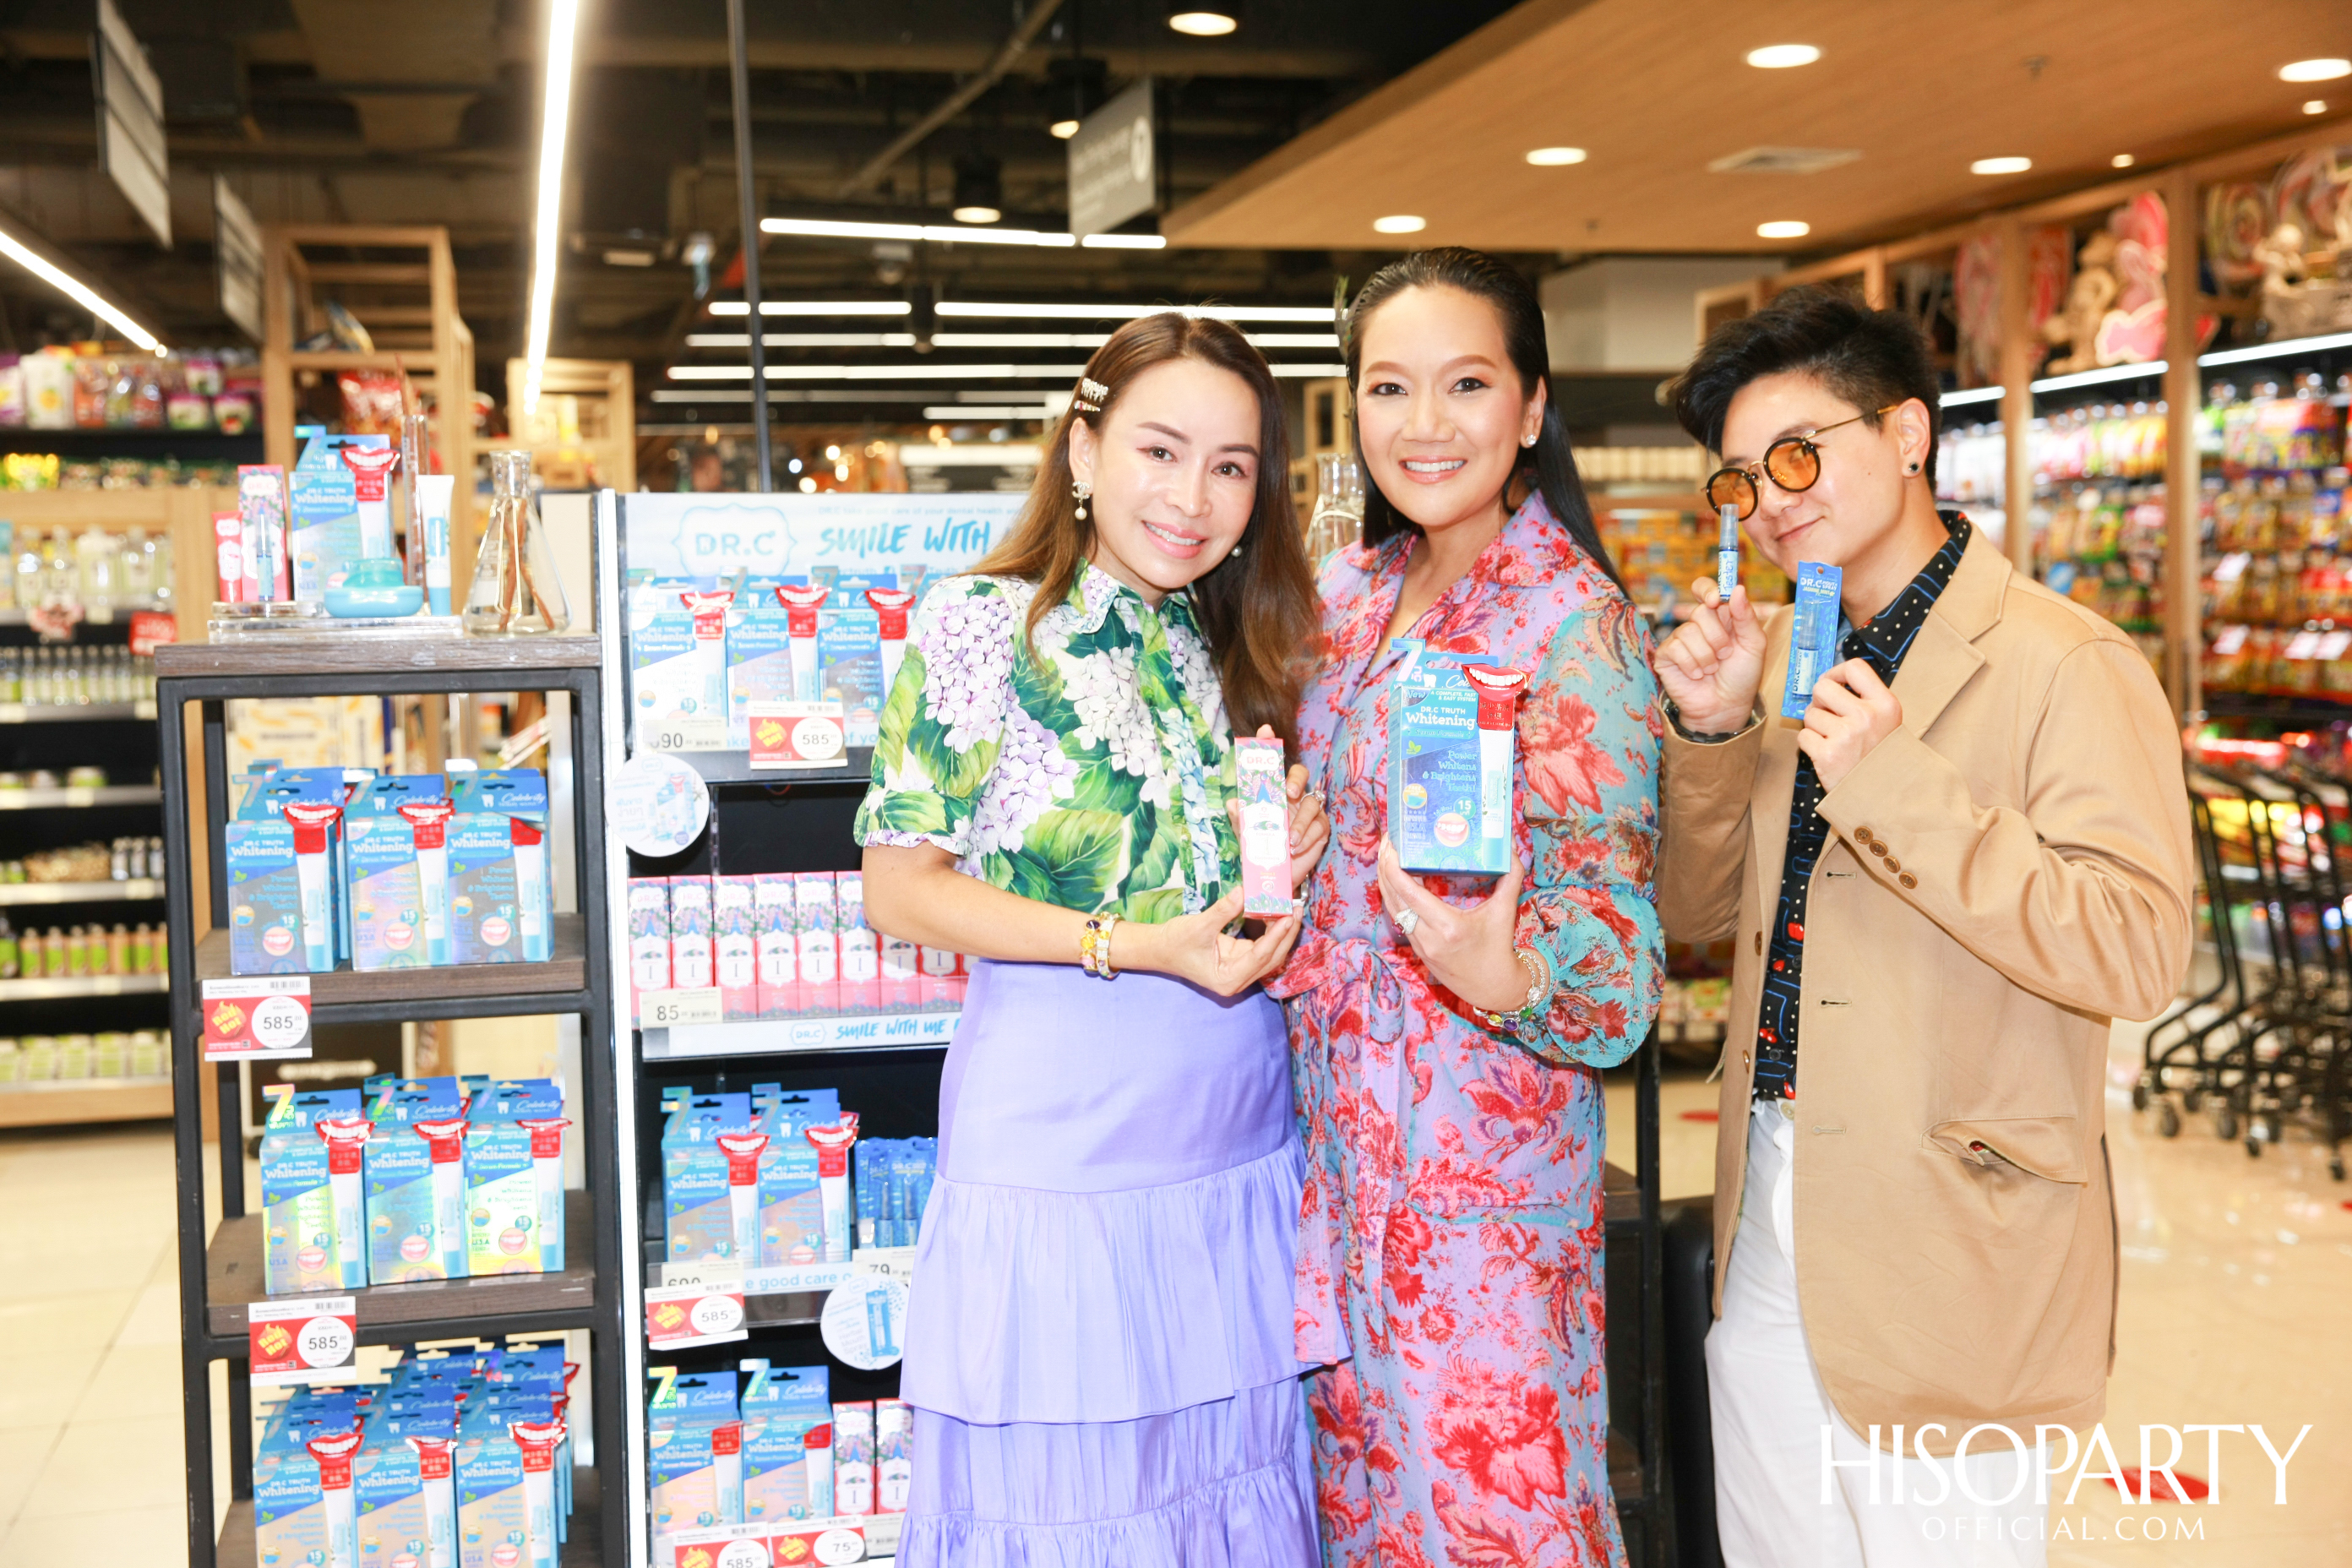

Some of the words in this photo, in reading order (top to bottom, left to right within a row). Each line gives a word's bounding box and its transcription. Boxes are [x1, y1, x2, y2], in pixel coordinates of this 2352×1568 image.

[295, 494, 355, 506] Whitening
[695, 531, 775, 556] DR.C
[816, 522, 912, 559] SMILE
[923, 516, 991, 556] WITH
[1800, 577, 1823, 589] DR.C
[636, 634, 693, 644] Whitening
[730, 630, 787, 642] Whitening
[822, 632, 878, 643] Whitening
[1391, 640, 1424, 682] 7
[1407, 689, 1426, 699] New
[1440, 706, 1466, 715] TRUTH
[1405, 712, 1476, 730] Whitening
[802, 733, 830, 745] 585
[1246, 756, 1276, 765] DR.C
[1448, 750, 1478, 760] Power
[1438, 760, 1477, 770] Whitens
[1430, 771, 1477, 783] Brightens
[1446, 783, 1477, 792] Teeth!
[1457, 800, 1472, 810] 15
[352, 842, 414, 855] Whitening
[451, 837, 510, 849] Whitening
[231, 846, 293, 858] Whitening
[403, 910, 416, 919] 15
[499, 906, 512, 914] 15
[282, 915, 296, 924] 15
[212, 1007, 237, 1026] Red
[656, 1004, 678, 1021] 85
[219, 1017, 242, 1035] Hot
[264, 1015, 293, 1031] 585
[836, 1019, 880, 1040] SMILE
[885, 1017, 917, 1037] WITH
[923, 1018, 948, 1036] ME
[796, 1028, 820, 1039] DR.C
[264, 1084, 295, 1122] 7
[471, 1150, 531, 1162] Whitening
[369, 1157, 430, 1169] Whitening
[264, 1166, 327, 1179] Whitening
[762, 1170, 817, 1181] Whitening
[671, 1179, 727, 1190] Whitening
[419, 1223, 432, 1232] 15
[315, 1233, 329, 1243] 15
[806, 1233, 818, 1243] 15
[716, 1242, 727, 1251] 15
[760, 1274, 800, 1291] good
[804, 1273, 837, 1284] care
[701, 1310, 729, 1322] 585
[258, 1328, 283, 1348] Red
[308, 1336, 338, 1350] 585
[265, 1338, 287, 1356] Hot
[740, 1358, 770, 1396] 7
[648, 1366, 678, 1403] 7
[747, 1442, 803, 1454] Whitening
[655, 1449, 711, 1461] Whitening
[461, 1467, 520, 1479] Whitening
[359, 1475, 419, 1488] Whitening
[258, 1484, 320, 1498] Whitening
[509, 1531, 522, 1540] 15
[408, 1540, 422, 1550] 15
[832, 1542, 851, 1553] 75
[308, 1551, 323, 1560] 15
[727, 1557, 754, 1568] 585
